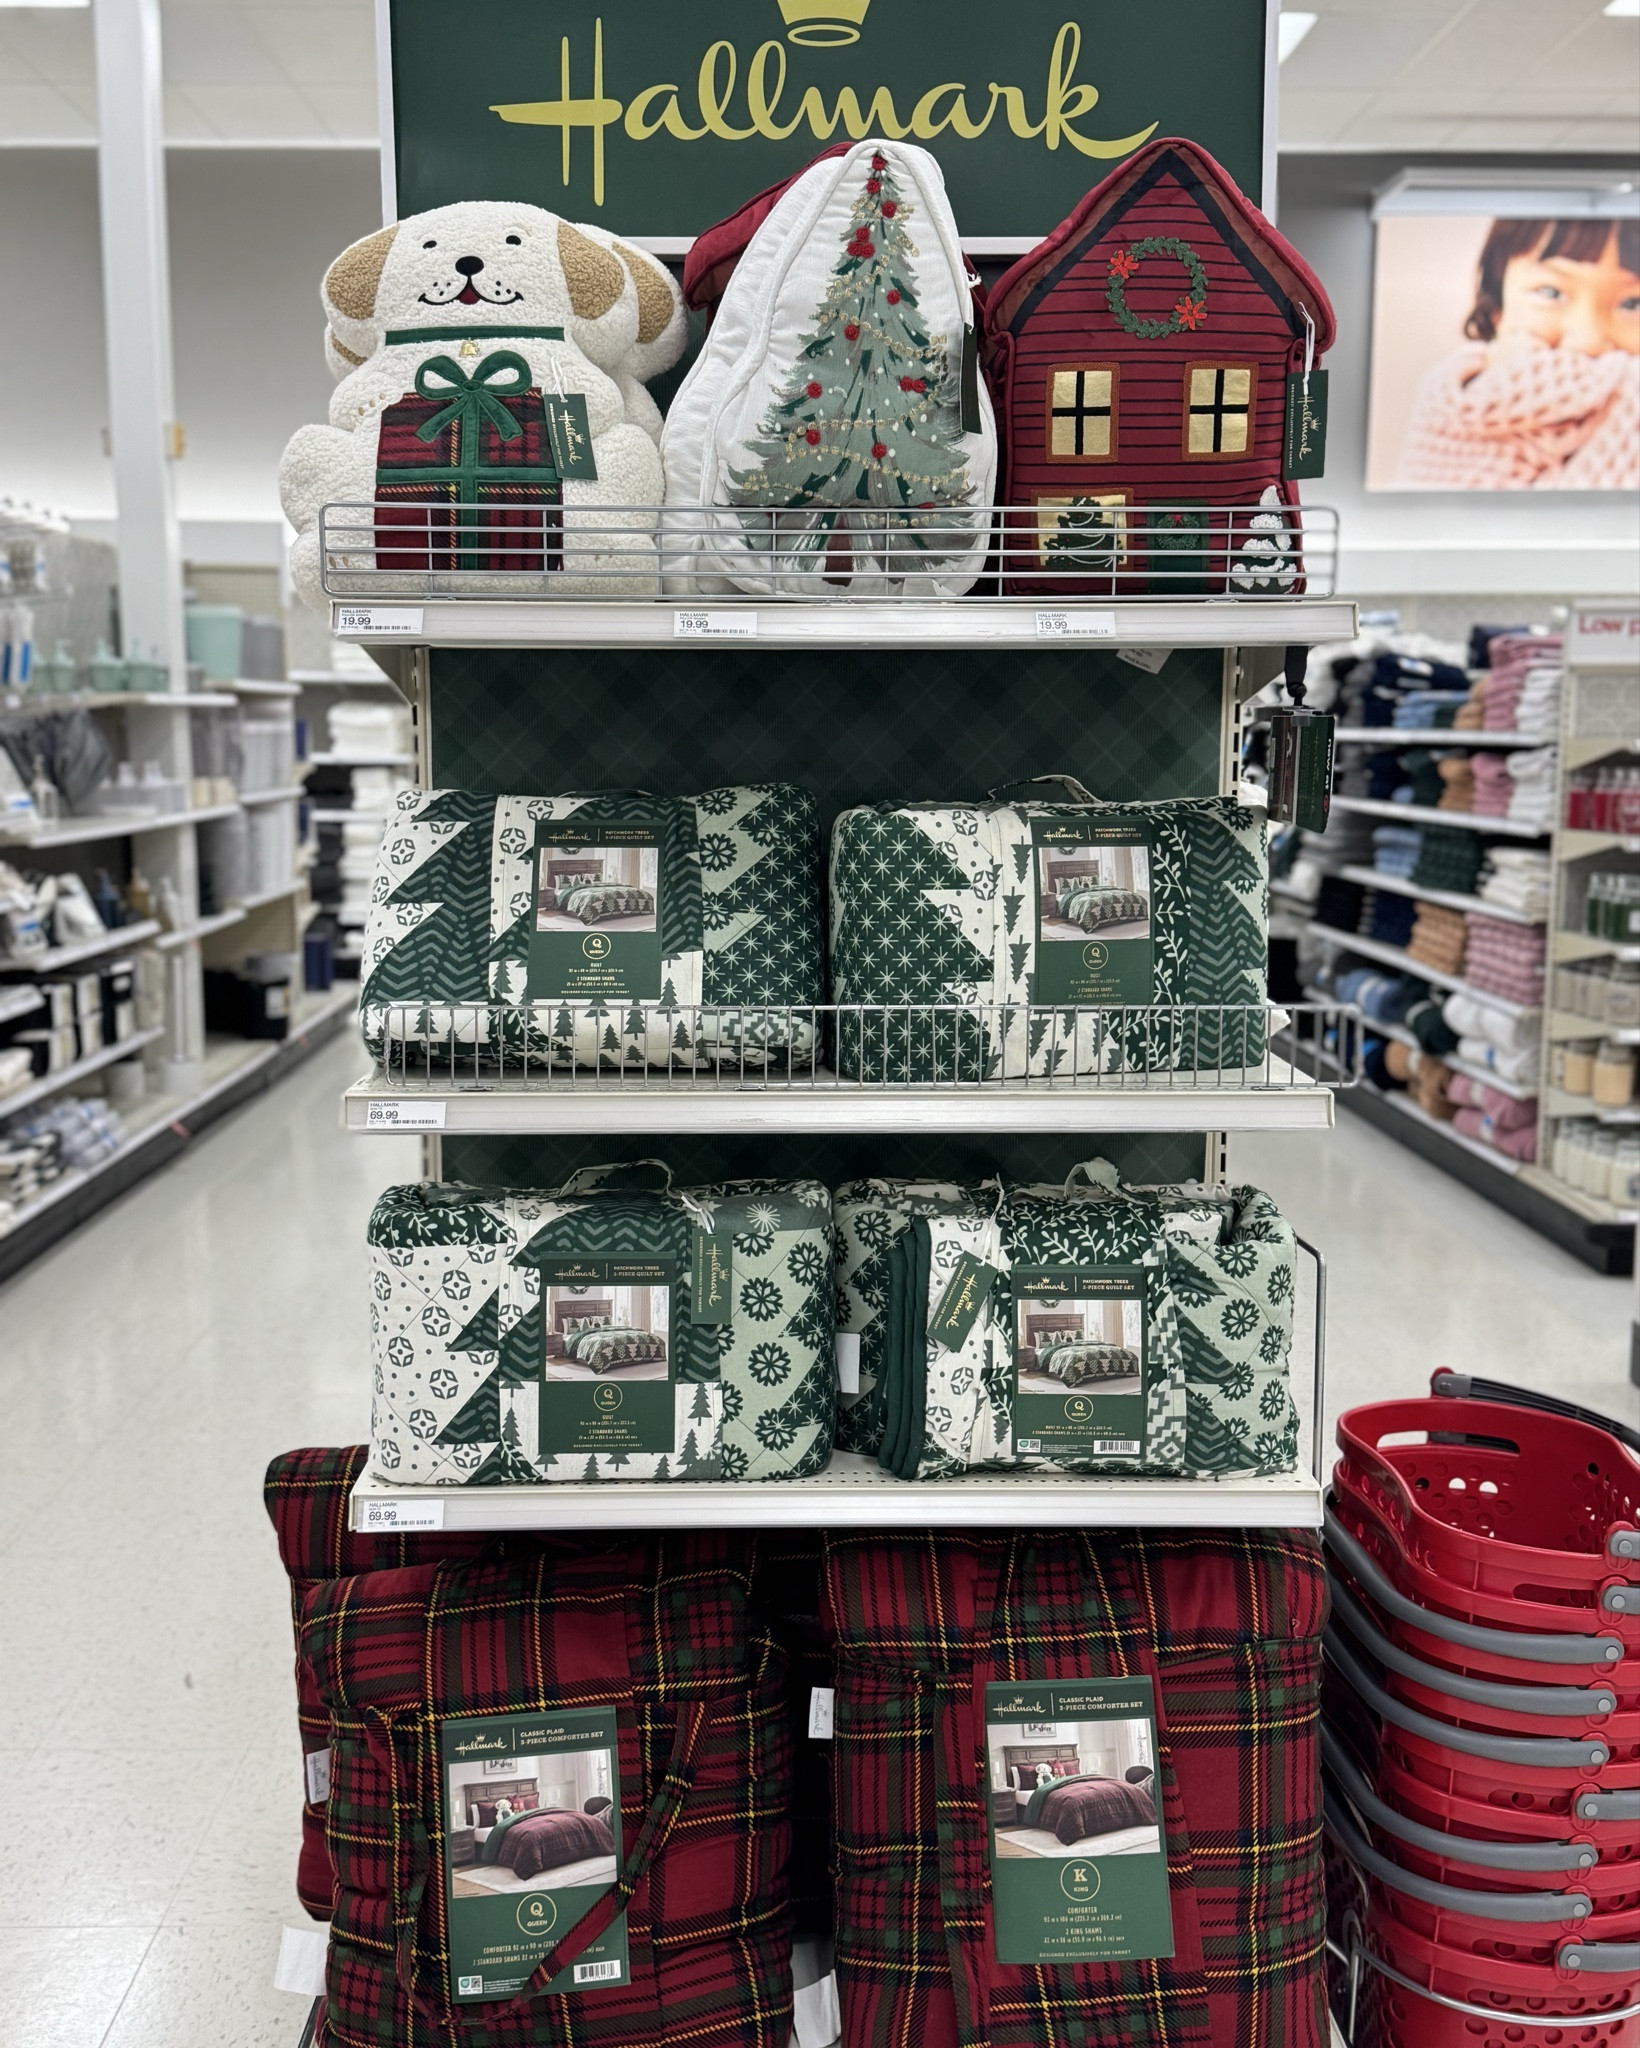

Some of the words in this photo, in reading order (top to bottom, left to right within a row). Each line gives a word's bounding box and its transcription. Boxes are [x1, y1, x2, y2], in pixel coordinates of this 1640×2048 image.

[488, 17, 1159, 206] Hallmark
[1297, 395, 1314, 460] Hallmark
[558, 410, 582, 465] Hallmark
[342, 617, 371, 625] 19.99
[681, 620, 708, 628] 19.99
[1039, 621, 1067, 629] 19.99
[1578, 612, 1622, 634] Low
[549, 832, 591, 843] Hallmark
[1043, 830, 1083, 842] Hallmark
[593, 939, 602, 948] Q
[1092, 947, 1100, 957] Q
[370, 1111, 398, 1119] 69.99
[555, 1268, 600, 1280] Hallmark
[706, 1243, 723, 1307] Hallmark
[1024, 1281, 1069, 1294] Hallmark
[946, 1274, 977, 1329] Hallmark
[604, 1389, 613, 1399] Q
[1075, 1401, 1084, 1411] Q
[369, 1511, 397, 1520] 69.99
[992, 1701, 1046, 1717] Hallmark
[521, 1730, 545, 1738] CLASSIC
[548, 1733, 589, 1742] COMFORTER
[455, 1737, 507, 1756] Hallmark
[1073, 1869, 1087, 1882] K
[530, 1902, 544, 1917] Q
[483, 1946, 511, 1954] COMFORTER
[477, 1957, 503, 1965] STANDARD
